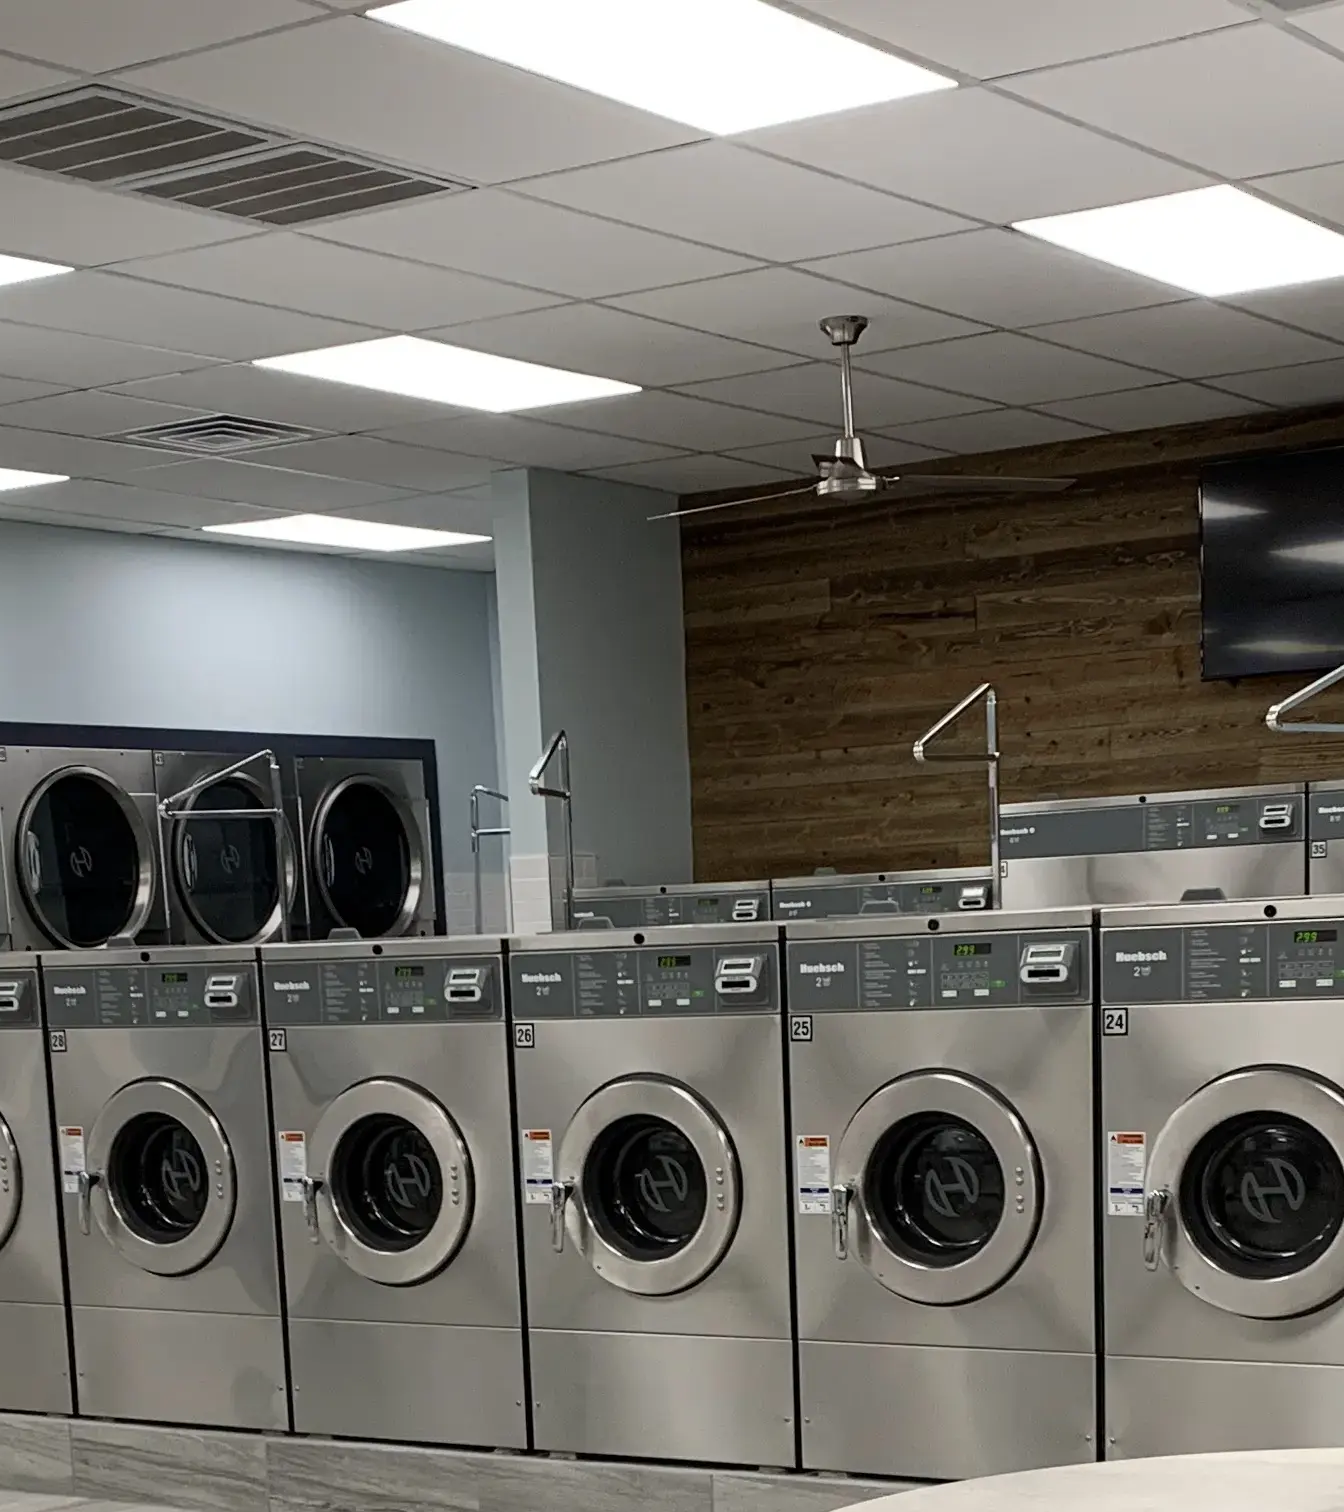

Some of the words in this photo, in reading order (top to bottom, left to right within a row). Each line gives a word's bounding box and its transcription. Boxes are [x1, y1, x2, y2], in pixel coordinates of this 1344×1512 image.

[1312, 844, 1325, 854] 35
[1296, 931, 1318, 942] 299
[956, 945, 975, 956] 299
[1115, 951, 1168, 962] Huebsch
[799, 962, 844, 974] Huebsch
[1133, 966, 1141, 977] 2
[815, 977, 822, 987] 2
[1105, 1014, 1124, 1030] 24
[793, 1021, 809, 1036] 25
[271, 1033, 284, 1046] 27
[517, 1029, 532, 1042] 26
